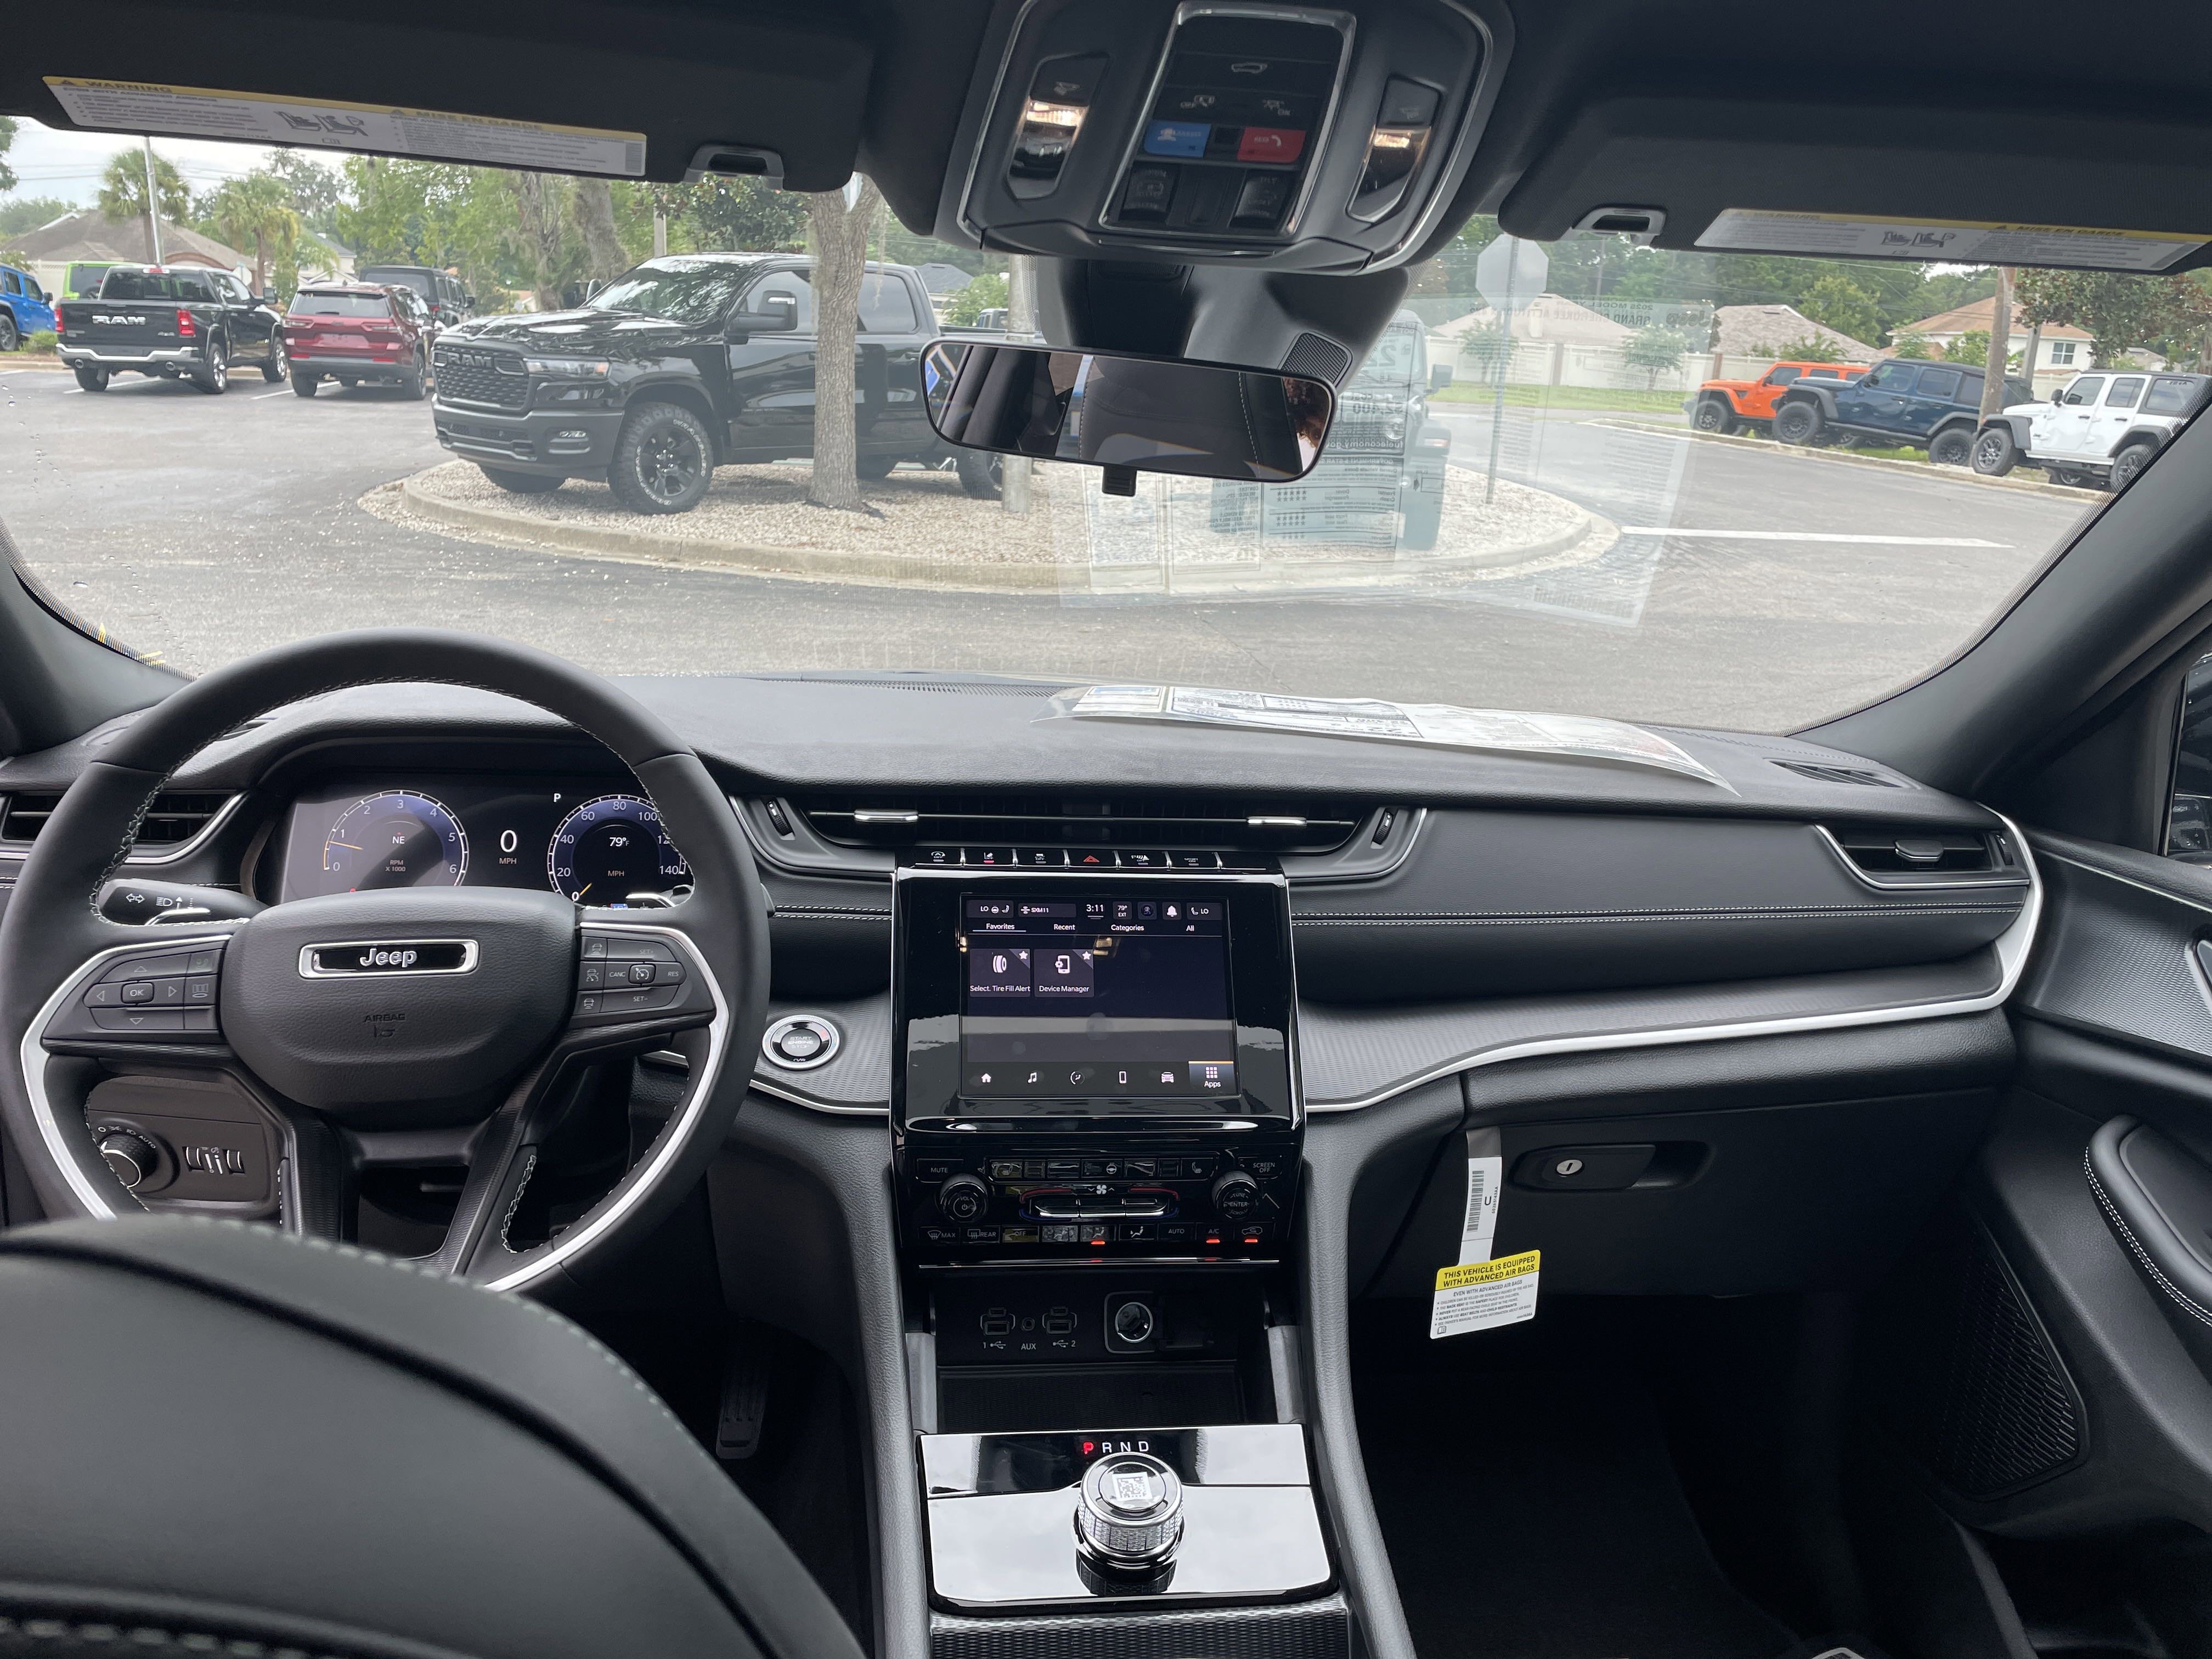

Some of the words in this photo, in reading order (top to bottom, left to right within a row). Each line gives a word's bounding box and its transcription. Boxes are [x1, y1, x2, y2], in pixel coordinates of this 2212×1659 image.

[92, 315, 146, 325] RAM
[447, 352, 492, 367] RAM
[554, 793, 561, 802] P
[397, 799, 404, 809] 3
[612, 802, 627, 810] 80
[364, 805, 371, 815] 2
[430, 808, 437, 817] 4
[580, 811, 595, 821] 60
[637, 811, 657, 821] 100
[340, 829, 345, 838] 1
[448, 832, 456, 842] 5
[392, 836, 405, 844] NE
[500, 830, 518, 853] 0
[560, 834, 574, 844] 40
[658, 834, 670, 844] 12
[333, 862, 340, 871] 0
[449, 864, 457, 873] 6
[659, 865, 679, 875] 140
[557, 867, 571, 877] 20
[571, 891, 580, 901] 0
[359, 948, 417, 968] Jeep
[364, 1014, 406, 1023] AIRBAG
[1204, 1080, 1221, 1088] Apps
[138, 1135, 156, 1149] AUTO
[1444, 1270, 1461, 1279] THIS
[1463, 1265, 1494, 1276] VEHICLE
[1495, 1263, 1502, 1271] IS
[1503, 1255, 1535, 1269] EQUIPPED
[1443, 1278, 1463, 1288] WITH
[1464, 1271, 1504, 1284] ADVANCED
[1505, 1269, 1516, 1277] AIR
[1517, 1263, 1535, 1273] BAGS
[1478, 1284, 1504, 1293] ADVANCED
[1083, 1441, 1094, 1454] P
[1102, 1442, 1112, 1453] R
[1120, 1441, 1131, 1452] N
[1138, 1441, 1149, 1452] D
